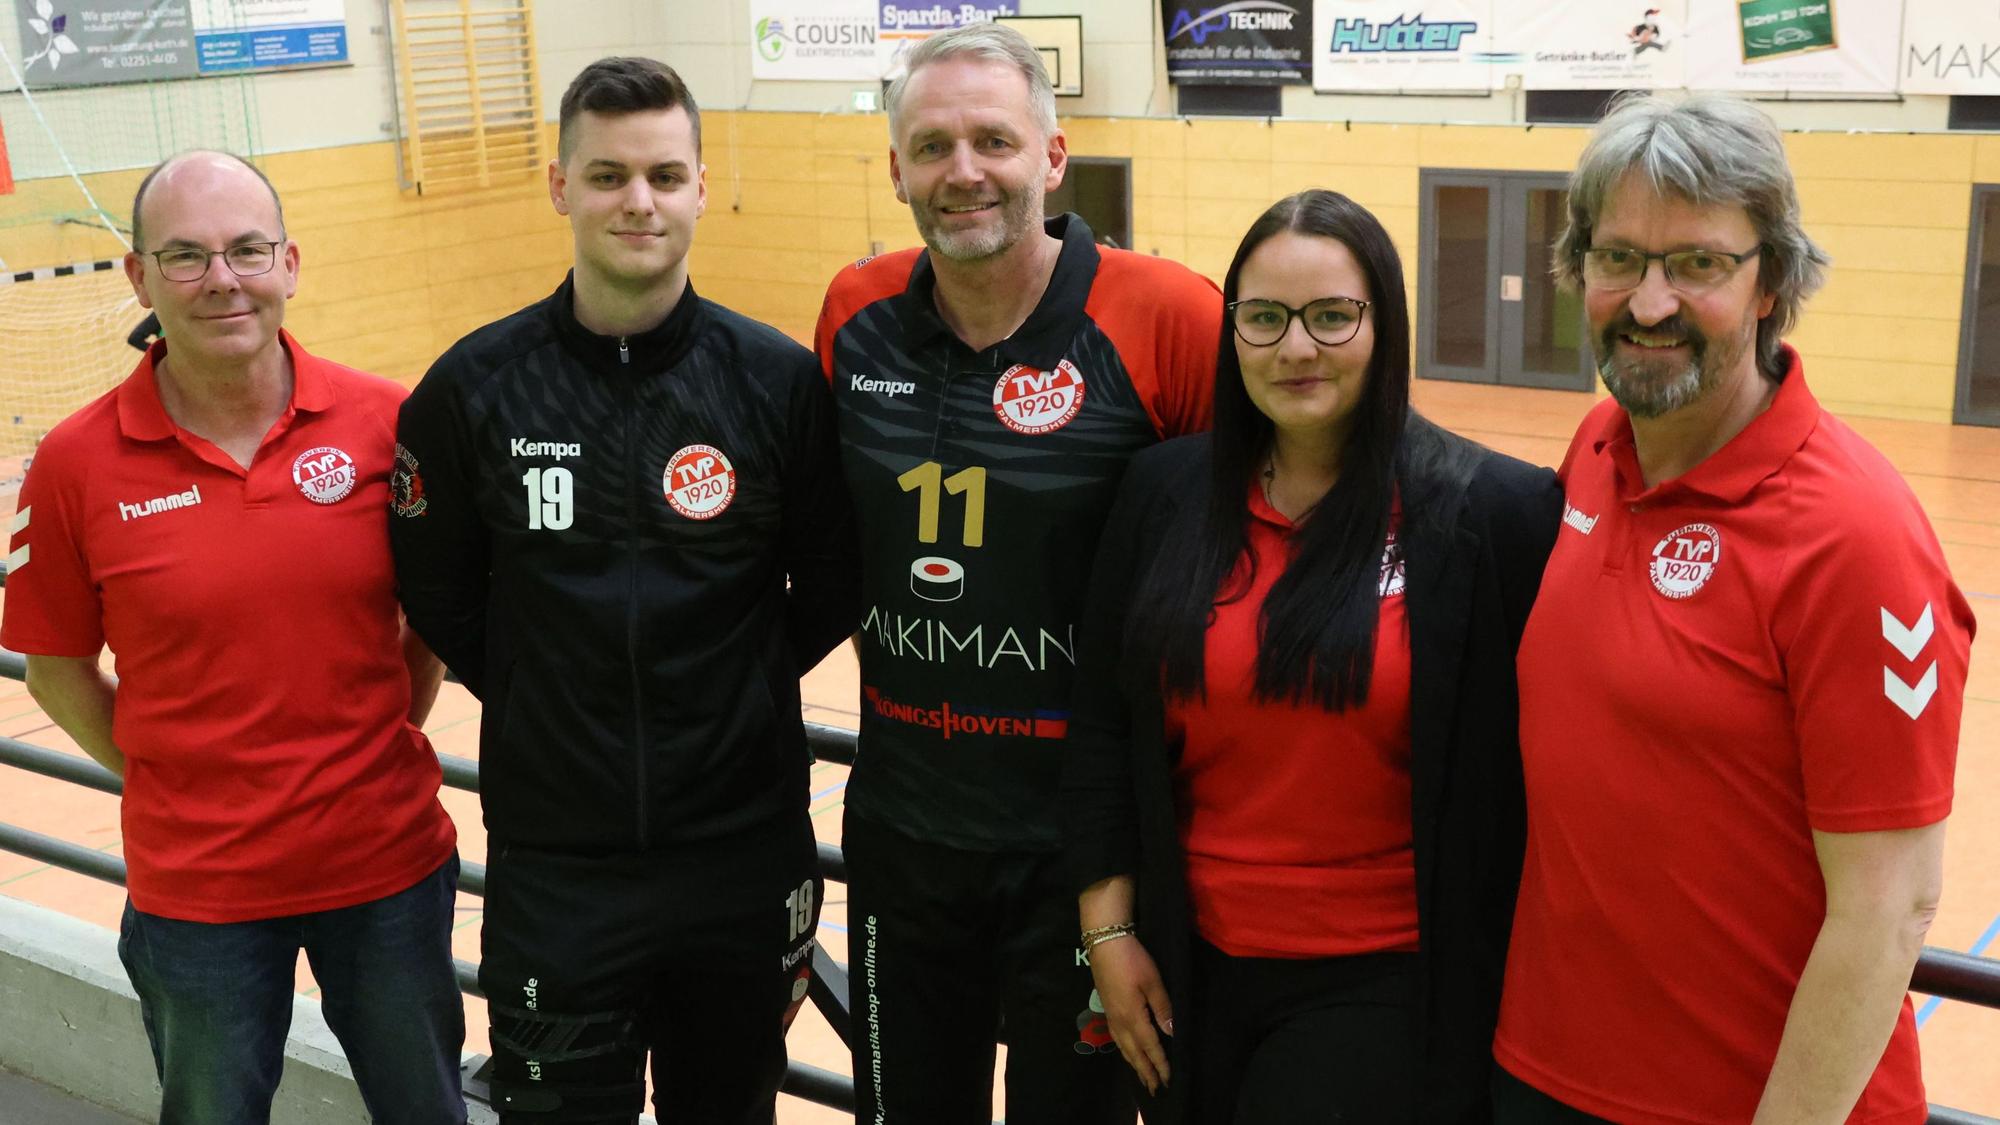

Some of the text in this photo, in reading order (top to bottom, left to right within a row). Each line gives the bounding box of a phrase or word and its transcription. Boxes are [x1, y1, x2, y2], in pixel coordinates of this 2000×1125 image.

[883, 4, 1015, 30] Sparda-Bank
[1228, 11, 1294, 30] TECHNIK
[795, 24, 876, 45] COUSIN
[1330, 12, 1478, 52] Hutter
[795, 47, 876, 57] ELEKTROTECHNIK
[850, 374, 916, 397] Kempa
[1011, 368, 1061, 396] TVP
[1015, 391, 1065, 418] 1920
[997, 406, 1077, 434] PALMERSHEIM
[293, 447, 342, 473] TURNVEREIN
[510, 437, 581, 461] Kempa
[302, 454, 336, 478] TVP
[665, 446, 723, 479] TURNVEREIN
[675, 456, 715, 486] TVP
[300, 479, 356, 504] PALMERSHEIM
[311, 470, 346, 494] 1920
[684, 479, 723, 505] 1920
[118, 484, 202, 521] hummel
[522, 466, 574, 531] 19
[670, 492, 733, 518] PALMERSHEIM
[897, 461, 987, 548] 11
[1663, 524, 1719, 547] TURNVEREIN
[1675, 537, 1712, 561] TVP
[1649, 562, 1704, 599] PALMERSHEIM
[1663, 561, 1701, 582] 1920
[861, 605, 1075, 671] MAKIMAN
[874, 696, 1031, 740] KÖNIGSHOVEN
[785, 879, 814, 942] 19
[782, 936, 815, 972] Kempa
